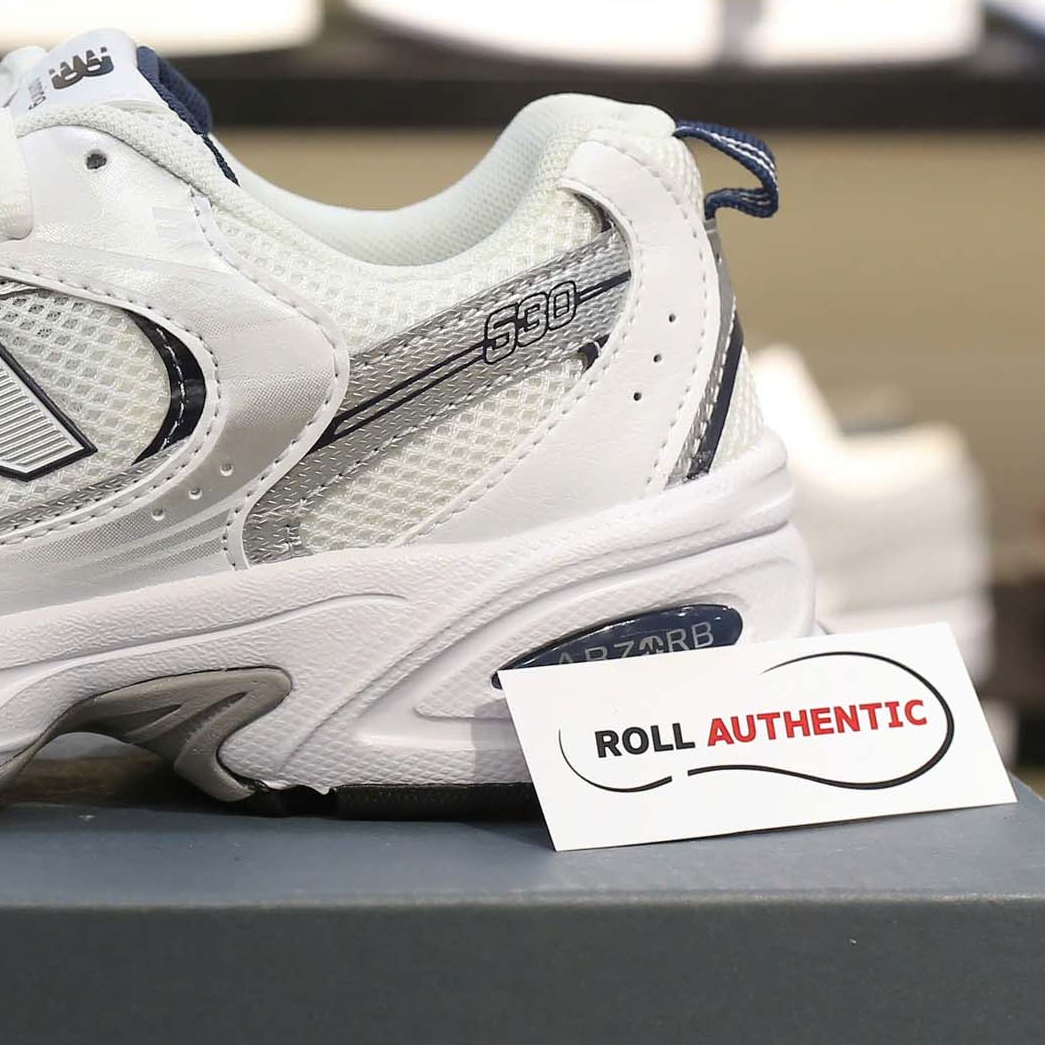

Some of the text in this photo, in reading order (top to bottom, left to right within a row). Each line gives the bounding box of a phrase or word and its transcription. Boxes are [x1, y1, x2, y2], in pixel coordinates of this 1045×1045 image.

[484, 280, 577, 365] 530
[595, 699, 928, 758] ROLL AUTHENTIC
